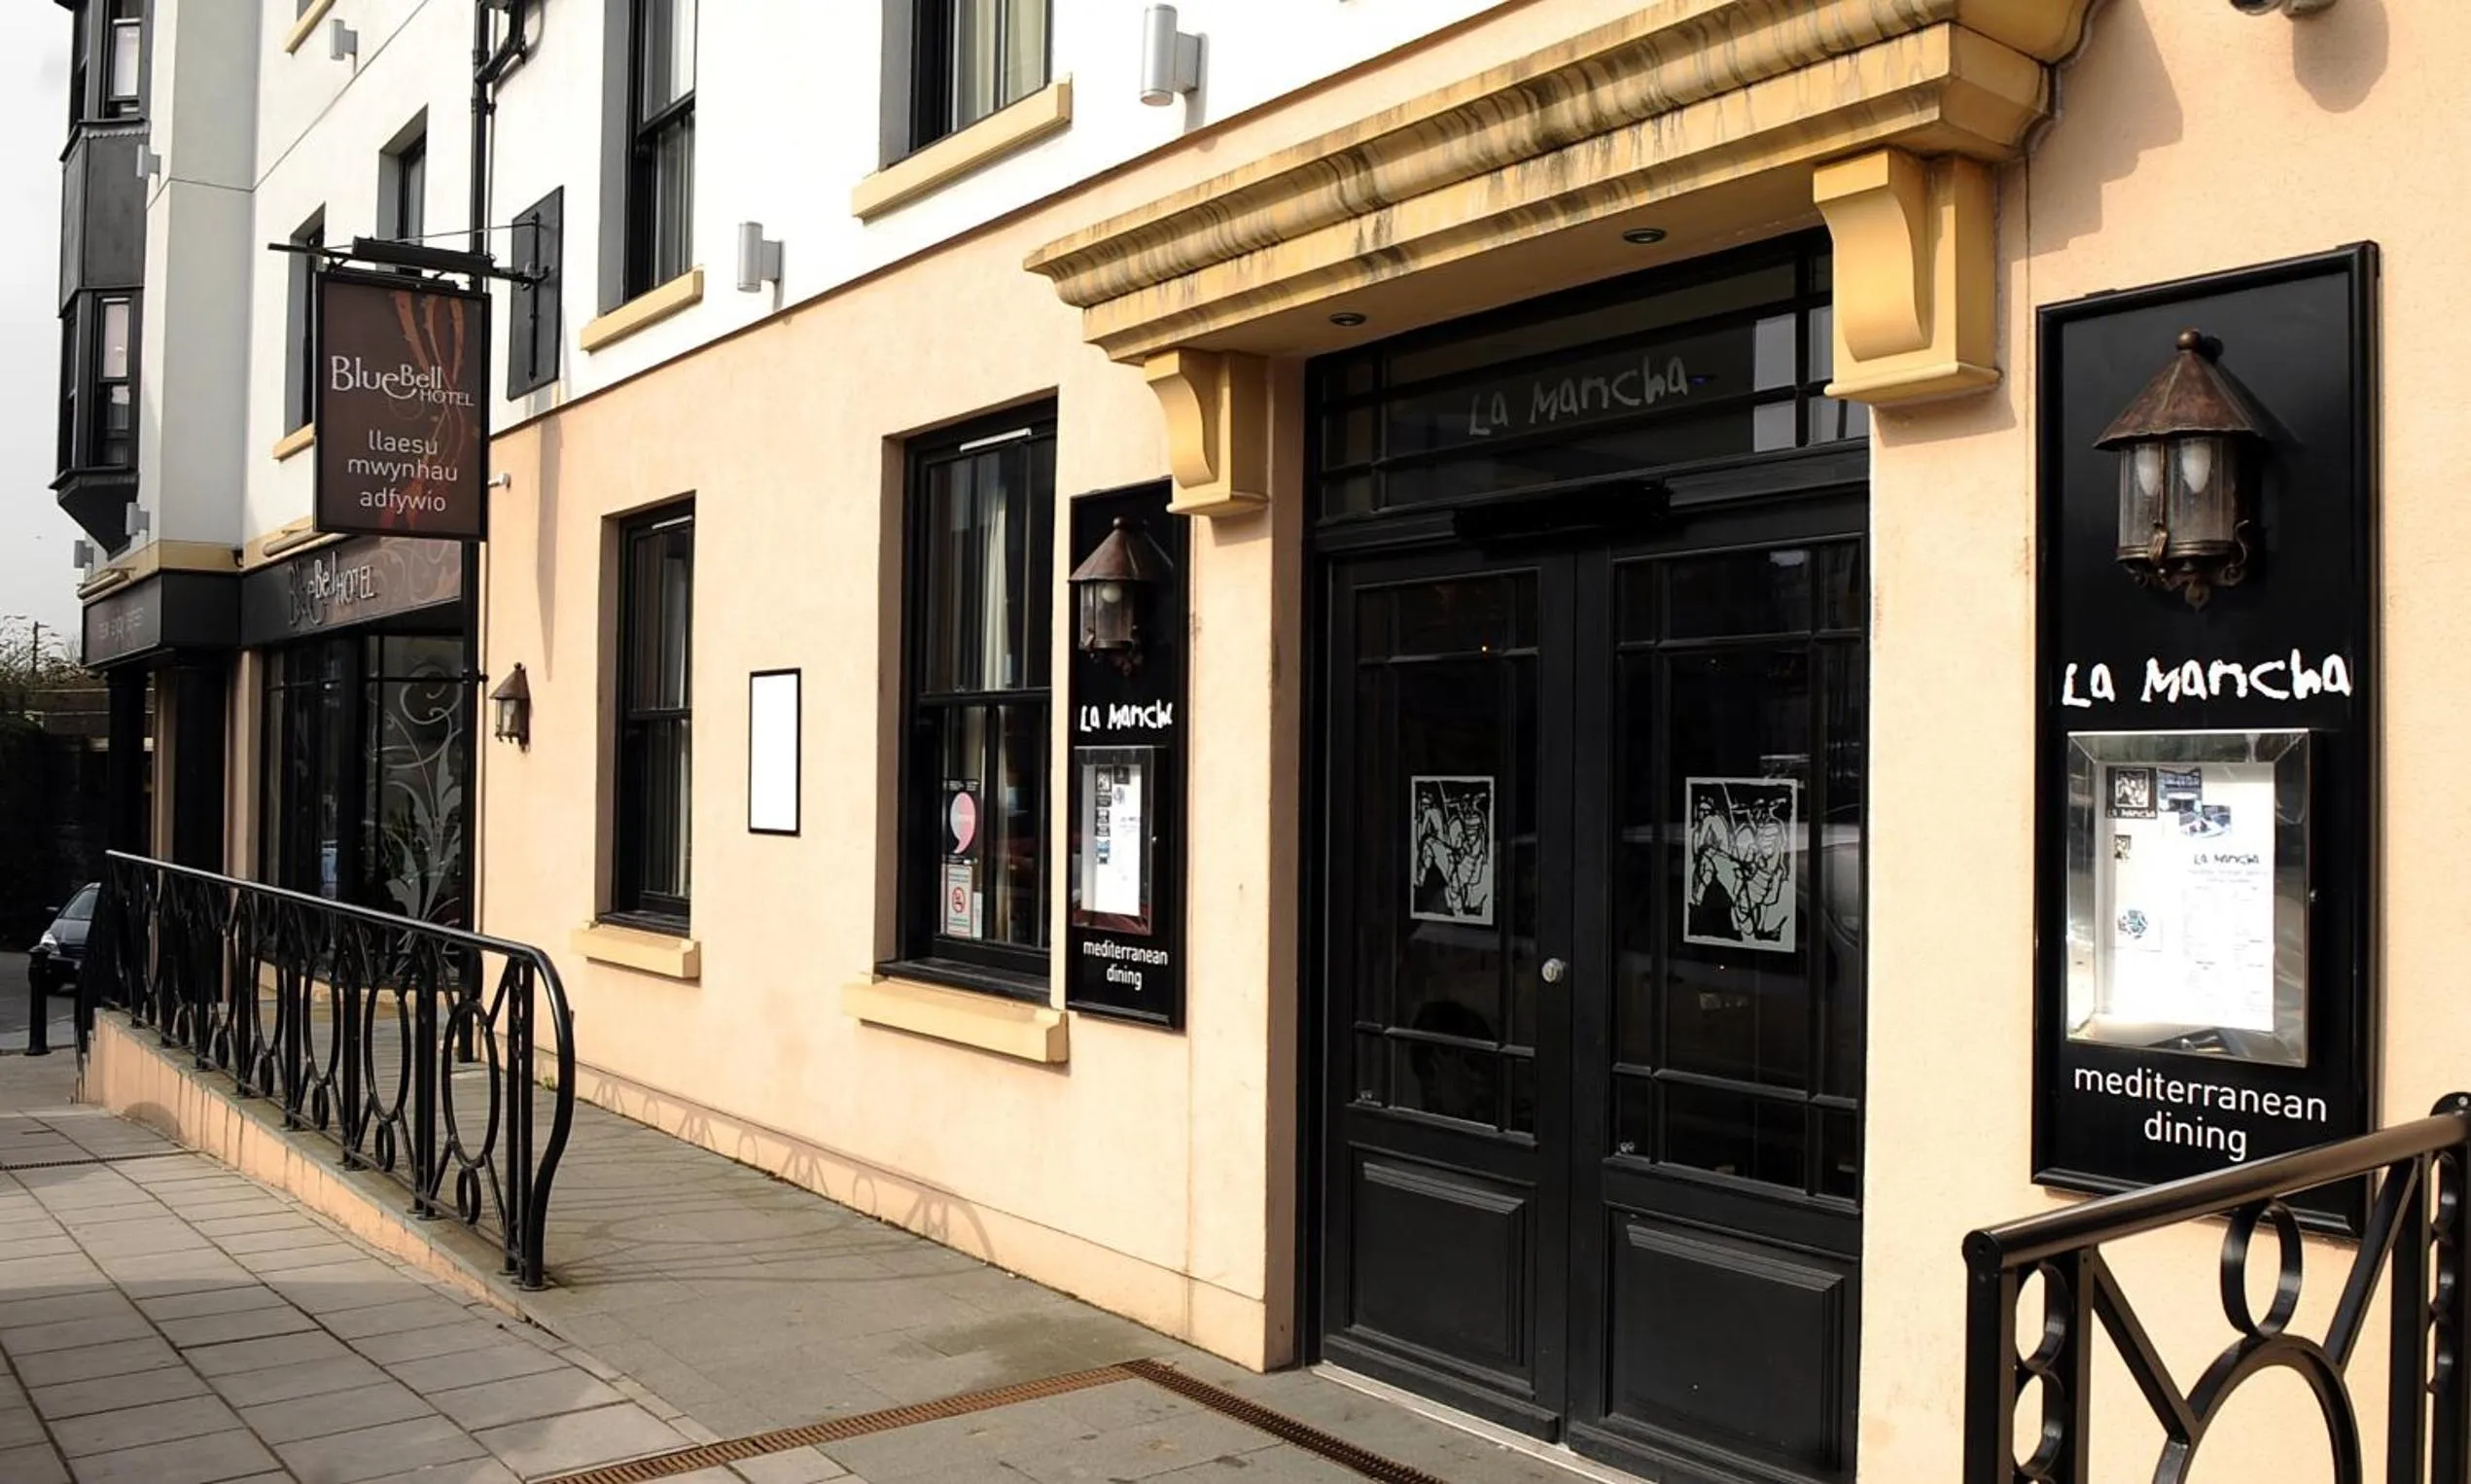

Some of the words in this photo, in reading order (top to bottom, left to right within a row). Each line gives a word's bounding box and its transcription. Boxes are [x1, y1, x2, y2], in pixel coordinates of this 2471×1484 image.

[331, 355, 441, 400] BlueBell
[419, 389, 475, 406] HOTEL
[369, 429, 438, 456] llaesu
[348, 458, 458, 481] mwynhau
[360, 487, 446, 514] adfywio
[2140, 648, 2351, 704] Mancha
[1083, 939, 1168, 966] mediterranean
[1107, 964, 1143, 991] dining
[2073, 1067, 2327, 1122] mediterranean
[2144, 1111, 2247, 1162] dining
